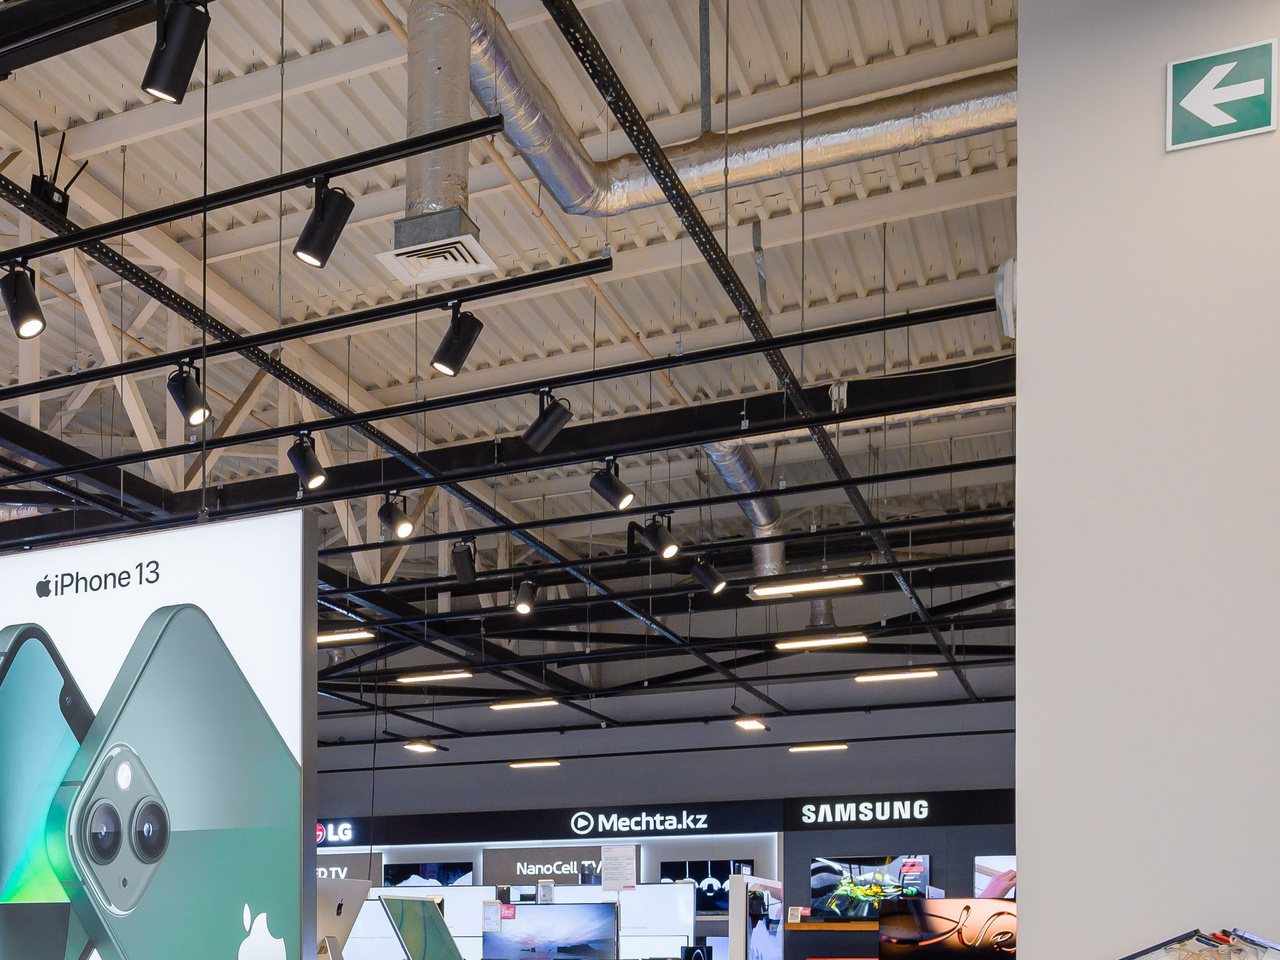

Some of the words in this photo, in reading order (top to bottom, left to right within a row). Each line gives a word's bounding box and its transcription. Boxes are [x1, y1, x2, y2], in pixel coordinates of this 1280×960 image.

[54, 570, 131, 597] iPhone
[135, 560, 160, 585] 13
[598, 810, 708, 832] Mechta.kz
[801, 799, 929, 824] SAMSUNG
[327, 823, 352, 842] LG
[329, 866, 348, 879] TV
[516, 860, 578, 876] NanoCell
